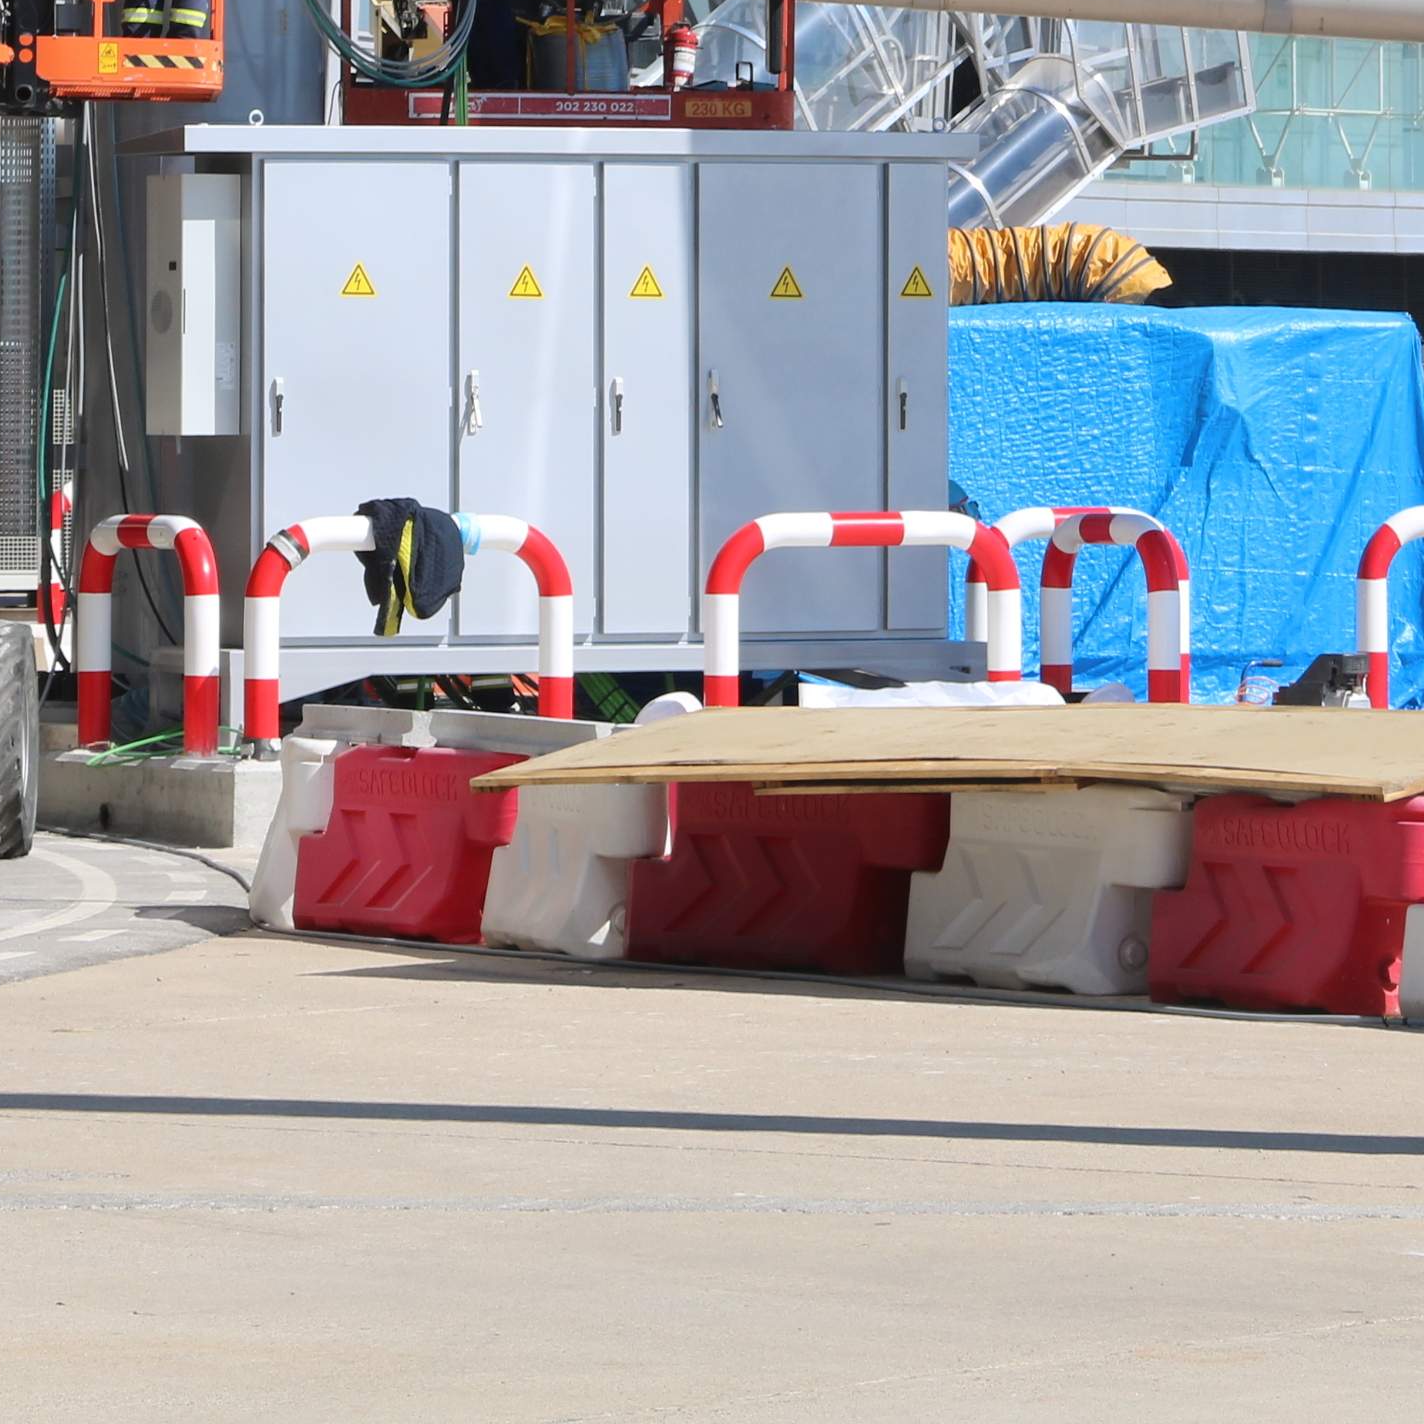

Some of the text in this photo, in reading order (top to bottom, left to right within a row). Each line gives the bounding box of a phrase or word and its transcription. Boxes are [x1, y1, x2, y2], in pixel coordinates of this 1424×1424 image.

[583, 101, 607, 112] 230
[610, 102, 634, 113] 022
[691, 102, 745, 116] 230 KG
